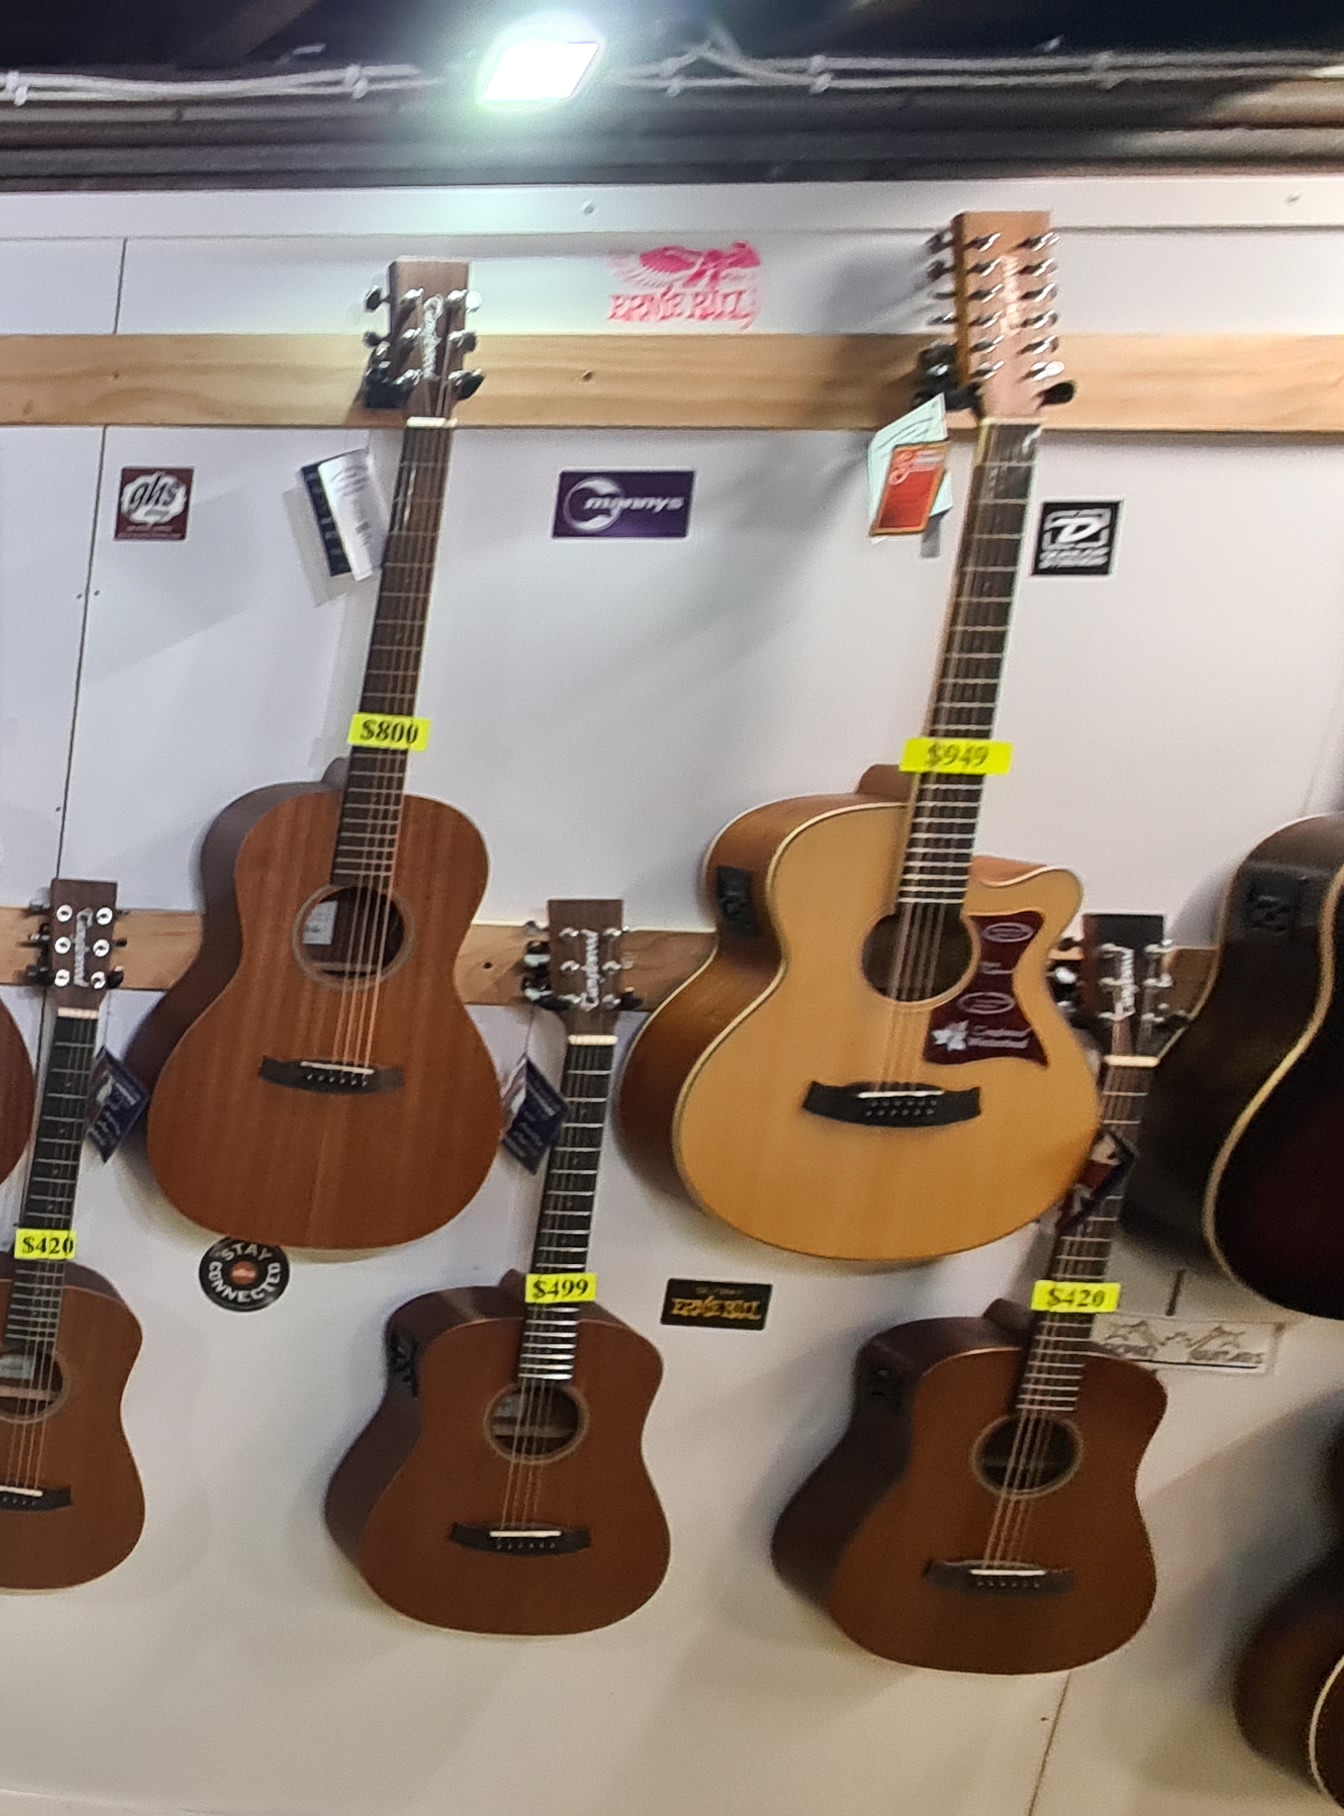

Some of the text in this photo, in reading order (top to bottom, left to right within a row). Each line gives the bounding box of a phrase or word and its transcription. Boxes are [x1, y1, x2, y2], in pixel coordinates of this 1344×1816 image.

[359, 718, 420, 745] $800
[926, 742, 990, 768] $949
[21, 1235, 74, 1255] $420
[221, 1242, 273, 1261] STAY
[208, 1261, 281, 1303] CONNECTED
[531, 1278, 590, 1300] $499
[1046, 1288, 1106, 1308] $420
